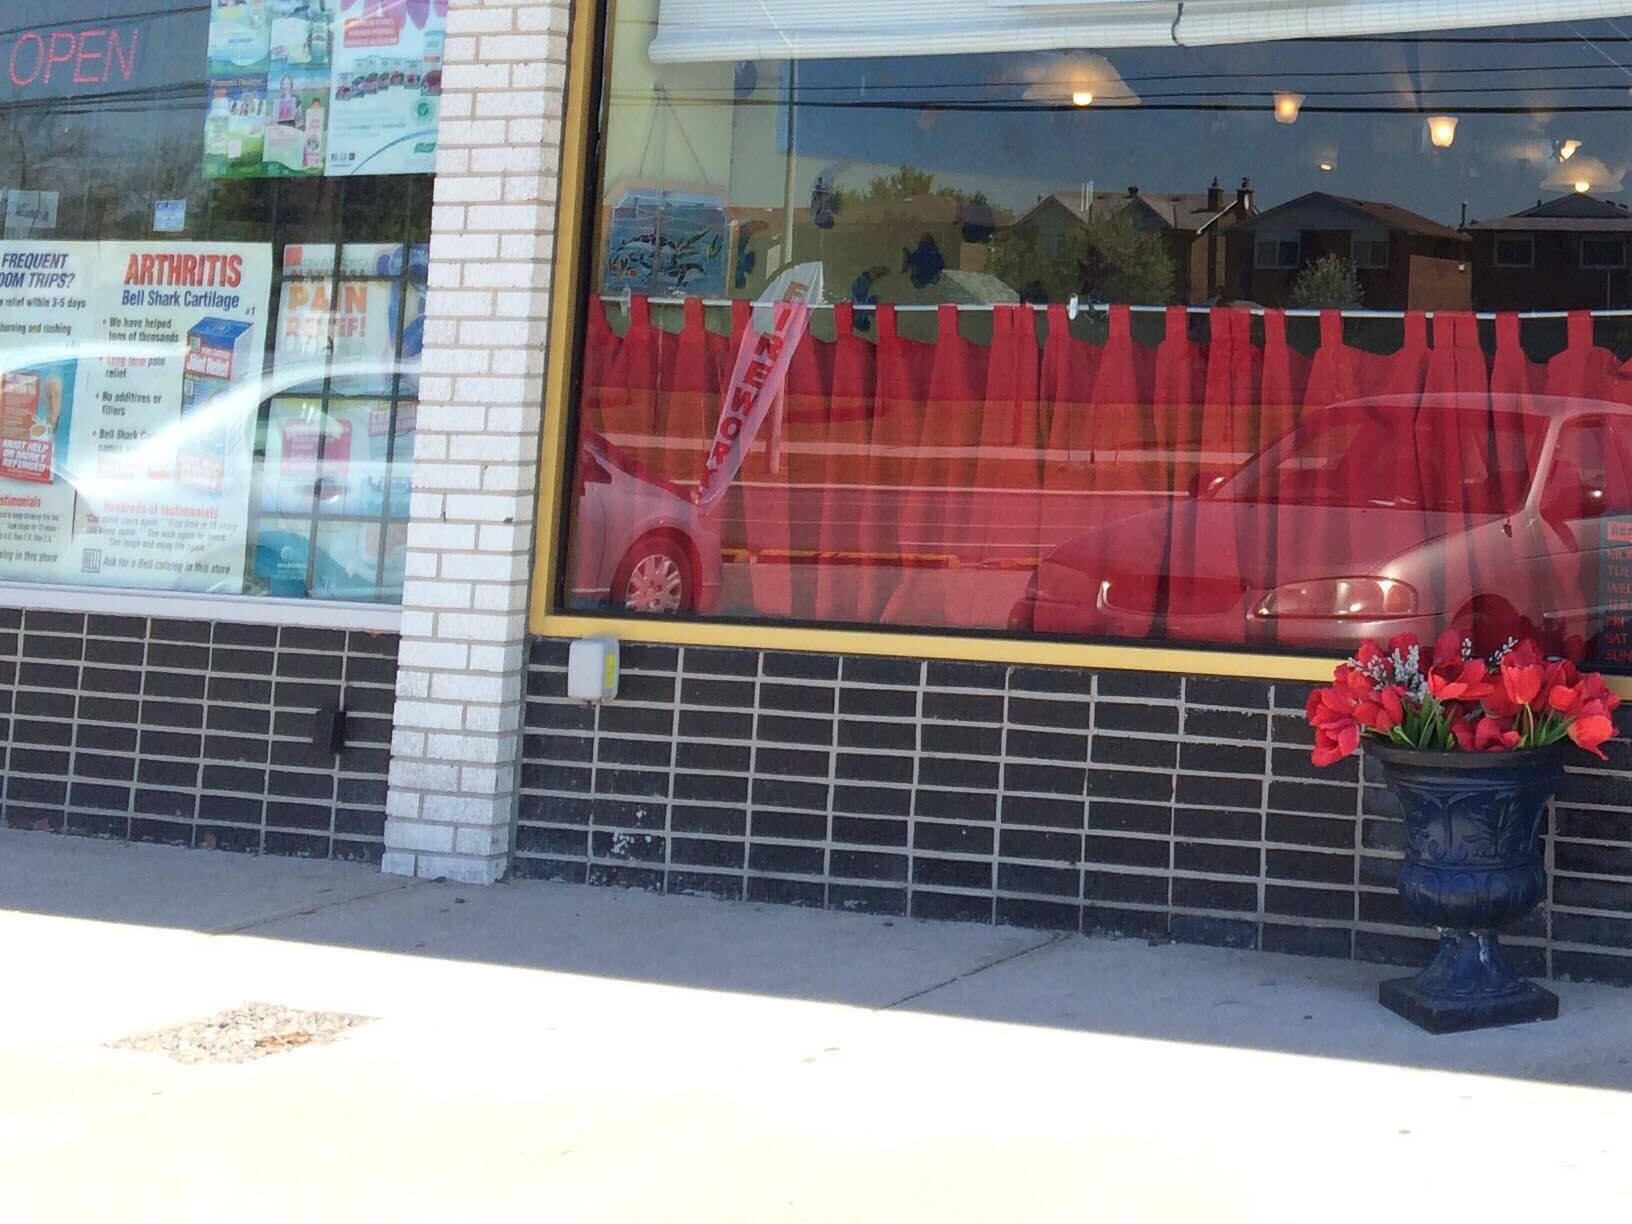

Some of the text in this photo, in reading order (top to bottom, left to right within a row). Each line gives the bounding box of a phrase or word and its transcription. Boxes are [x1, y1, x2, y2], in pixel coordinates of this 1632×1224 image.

[8, 29, 139, 87] OPEN
[0, 252, 70, 270] FREQUENT
[123, 252, 244, 288] ARTHRITIS
[28, 272, 76, 288] TRIPS?
[5, 296, 24, 307] relief
[26, 297, 50, 307] within
[52, 297, 65, 308] 3-5
[67, 297, 87, 311] days
[121, 289, 241, 312] Bell Shark Cartilage
[286, 281, 368, 312] PAN
[28, 323, 41, 333] and
[109, 317, 172, 330] We have helped
[108, 330, 179, 343] tens of thousands
[147, 357, 166, 369] pain
[105, 367, 127, 379] relief
[101, 390, 162, 405] No additives or
[102, 404, 126, 417] fillers
[24, 550, 37, 562] this
[40, 551, 58, 563] store
[103, 556, 116, 567] Ask
[118, 557, 130, 568] for
[137, 557, 154, 569] Bell
[195, 562, 209, 572] this
[211, 563, 231, 575] store
